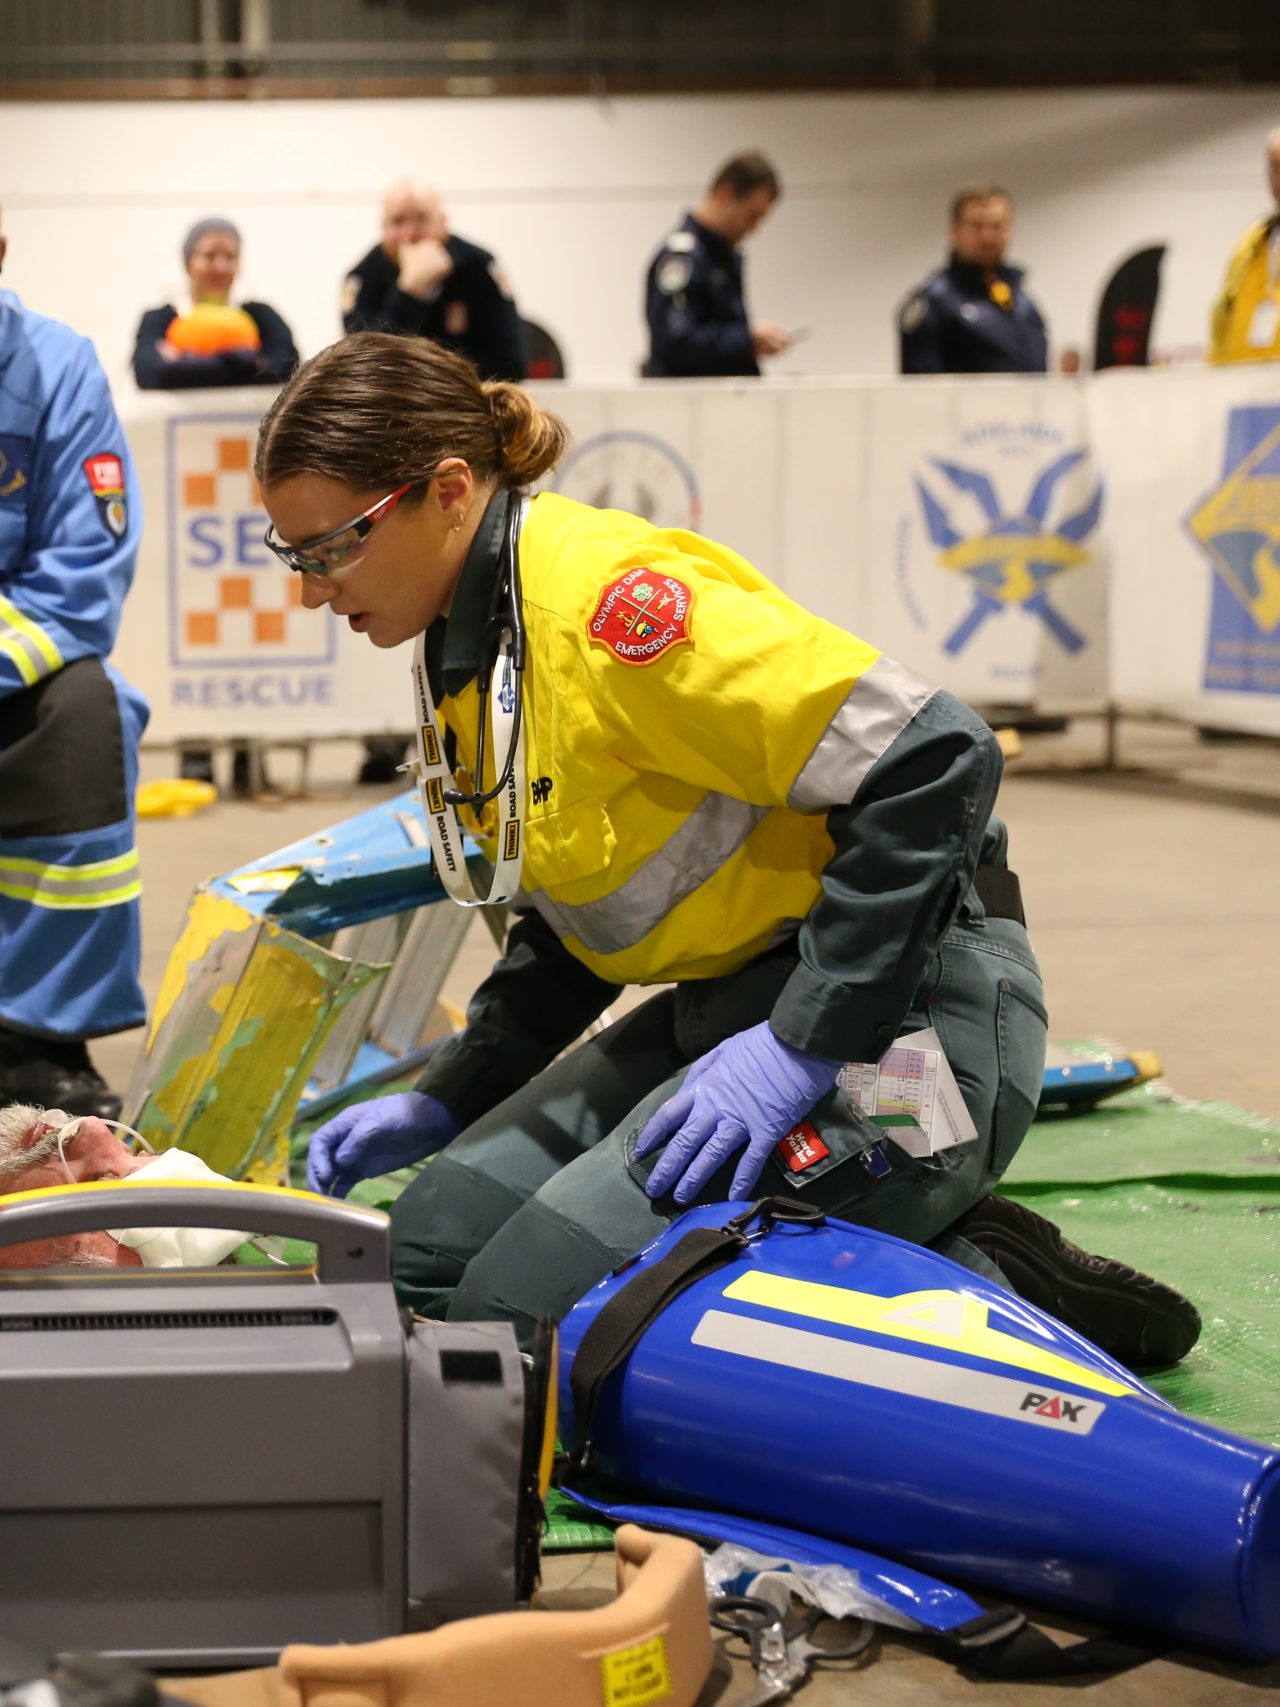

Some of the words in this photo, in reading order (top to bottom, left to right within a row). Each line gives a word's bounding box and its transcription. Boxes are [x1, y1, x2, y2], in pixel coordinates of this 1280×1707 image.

[188, 515, 271, 567] SE
[593, 585, 625, 632] OLYMPIC
[622, 568, 647, 586] DAM
[663, 578, 687, 622] SERVICES
[615, 622, 678, 656] EMERGENCY
[172, 675, 334, 709] RESCUE
[417, 664, 426, 697] SAFETY
[420, 699, 430, 723] ROAD
[509, 791, 517, 818] ROAD
[428, 778, 442, 809] THINK!
[436, 815, 448, 843] ROAD
[442, 842, 457, 872] SAFETY
[507, 824, 517, 856] THINK!
[786, 1134, 808, 1164] Yakka
[795, 1132, 816, 1157] Hard
[1019, 1391, 1088, 1423] PAX
